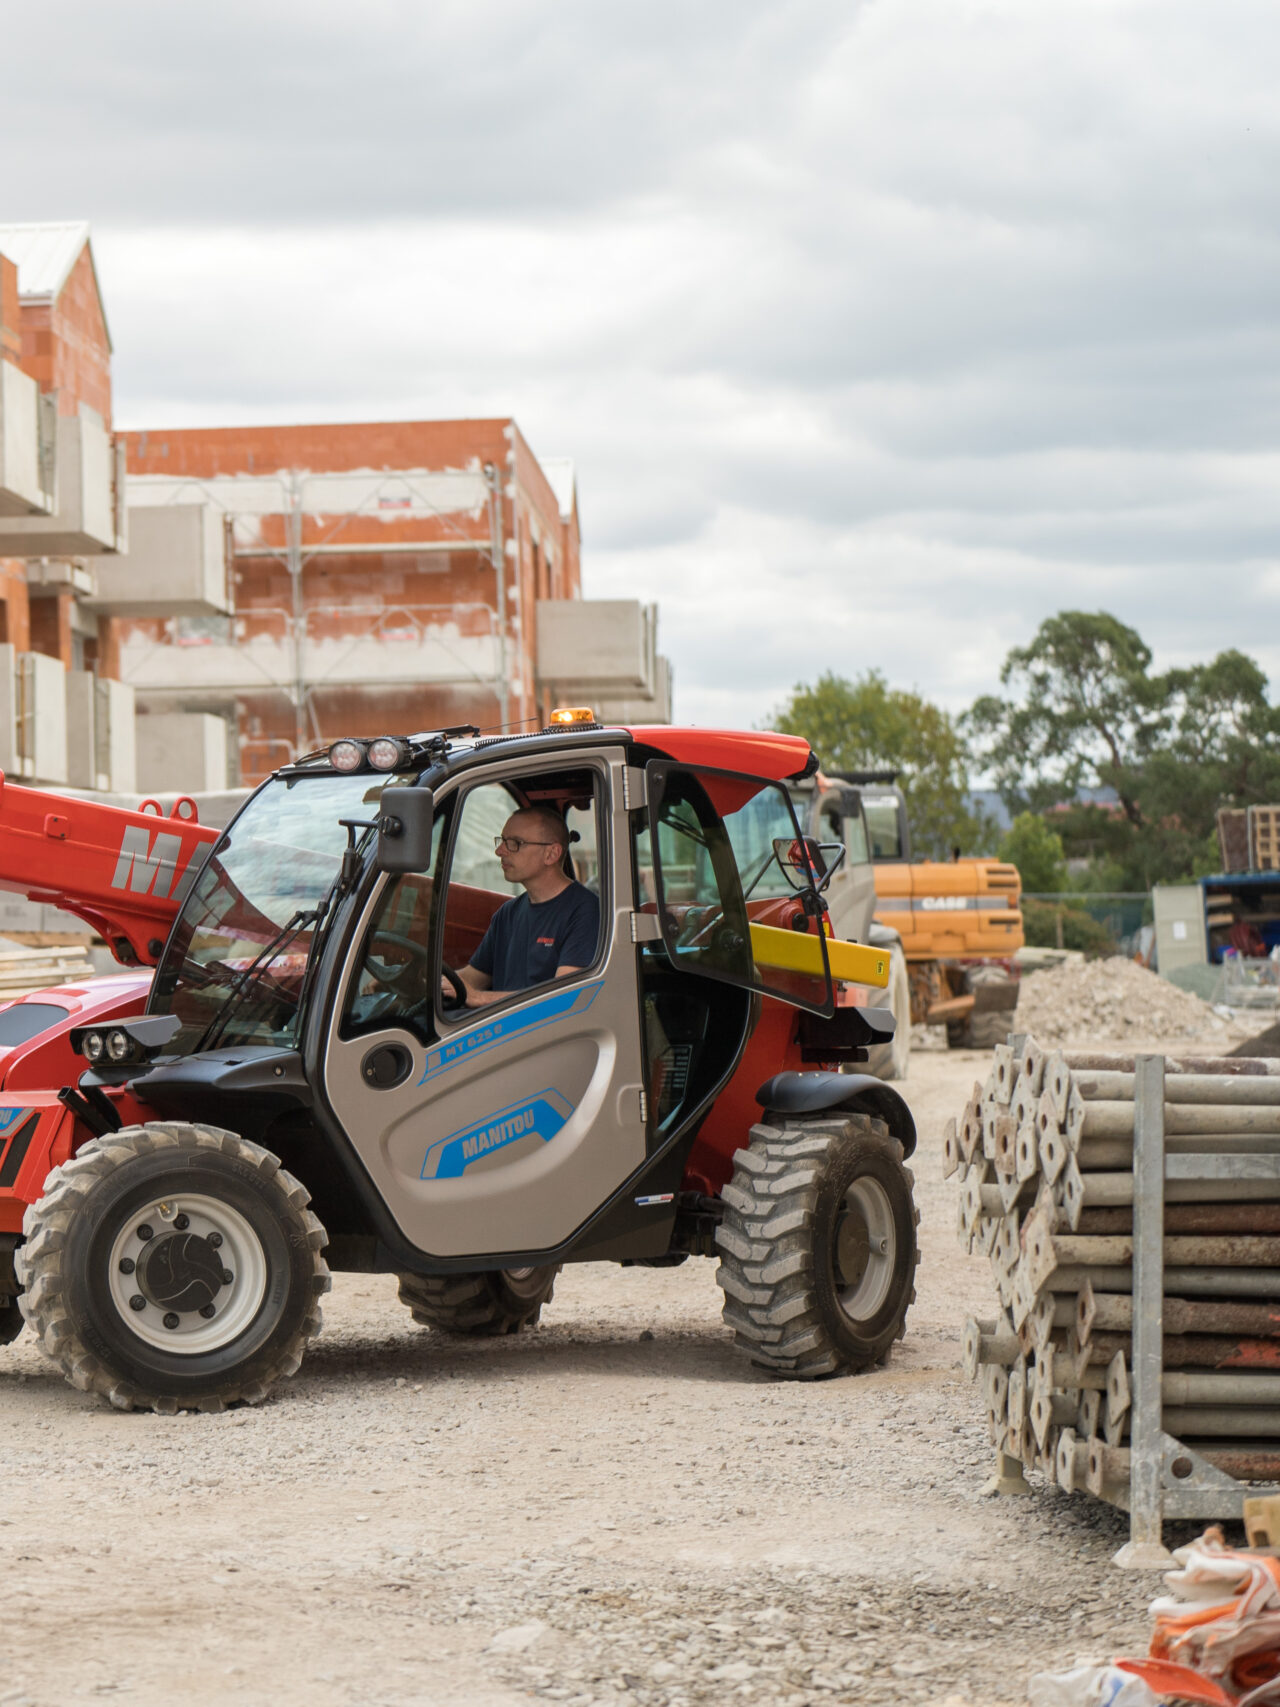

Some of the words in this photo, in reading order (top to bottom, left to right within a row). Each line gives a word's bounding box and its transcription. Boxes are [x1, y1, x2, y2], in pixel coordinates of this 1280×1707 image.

[922, 896, 967, 910] CASE
[445, 1041, 465, 1059] MT
[466, 1028, 493, 1048] 625
[461, 1108, 535, 1160] MANITOU
